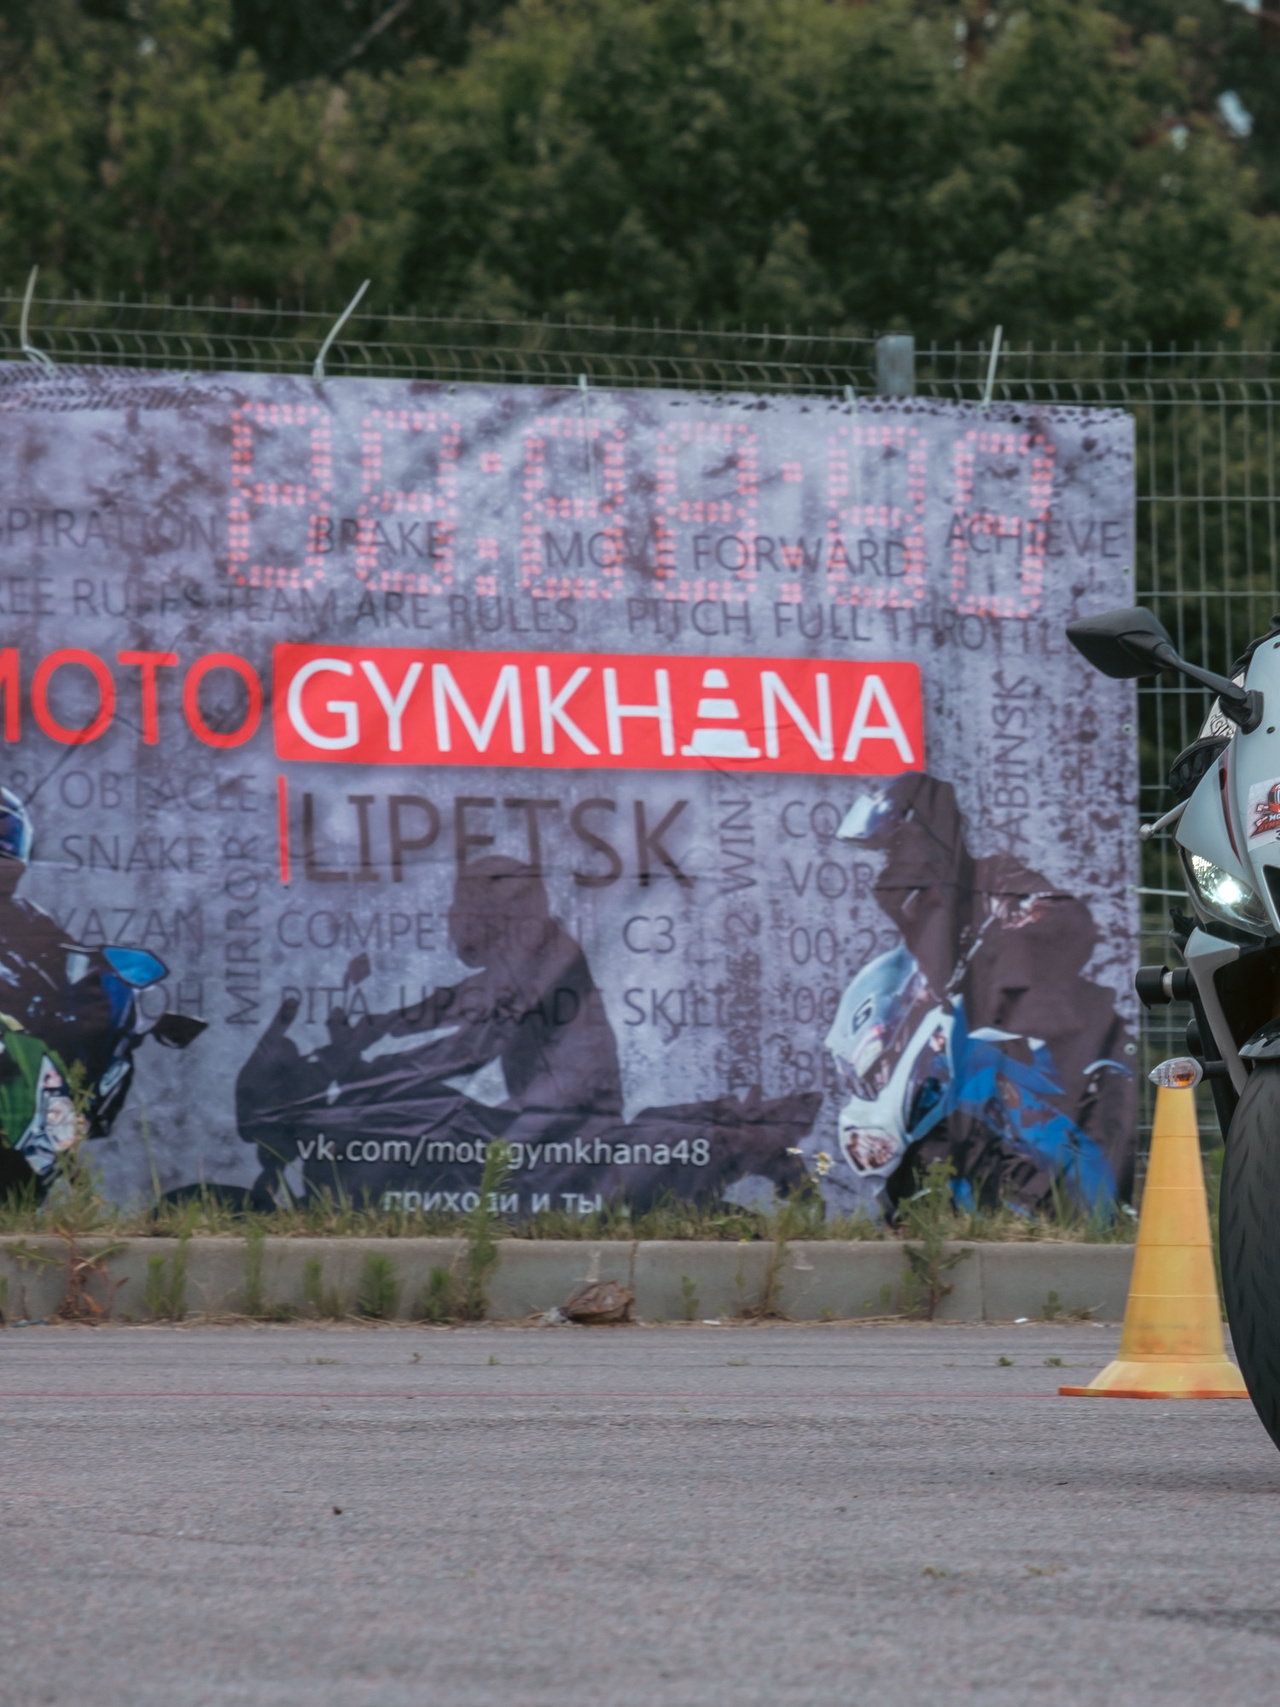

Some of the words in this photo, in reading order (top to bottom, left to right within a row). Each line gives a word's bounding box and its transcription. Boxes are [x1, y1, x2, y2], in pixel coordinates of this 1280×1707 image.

[0, 507, 217, 552] PIRATION
[314, 516, 446, 560] BRAKE
[0, 576, 54, 616] EE
[354, 590, 430, 630] ARE
[448, 593, 578, 634] RULES
[628, 595, 752, 638] PITCH
[775, 598, 872, 642] FULL
[884, 604, 1078, 657] THROTTL
[61, 834, 207, 874] SNAKE
[225, 834, 262, 1027] MIRROR
[622, 915, 678, 955] C3
[297, 1134, 711, 1170] vk.com/motgymkhana48
[531, 1192, 551, 1215] и
